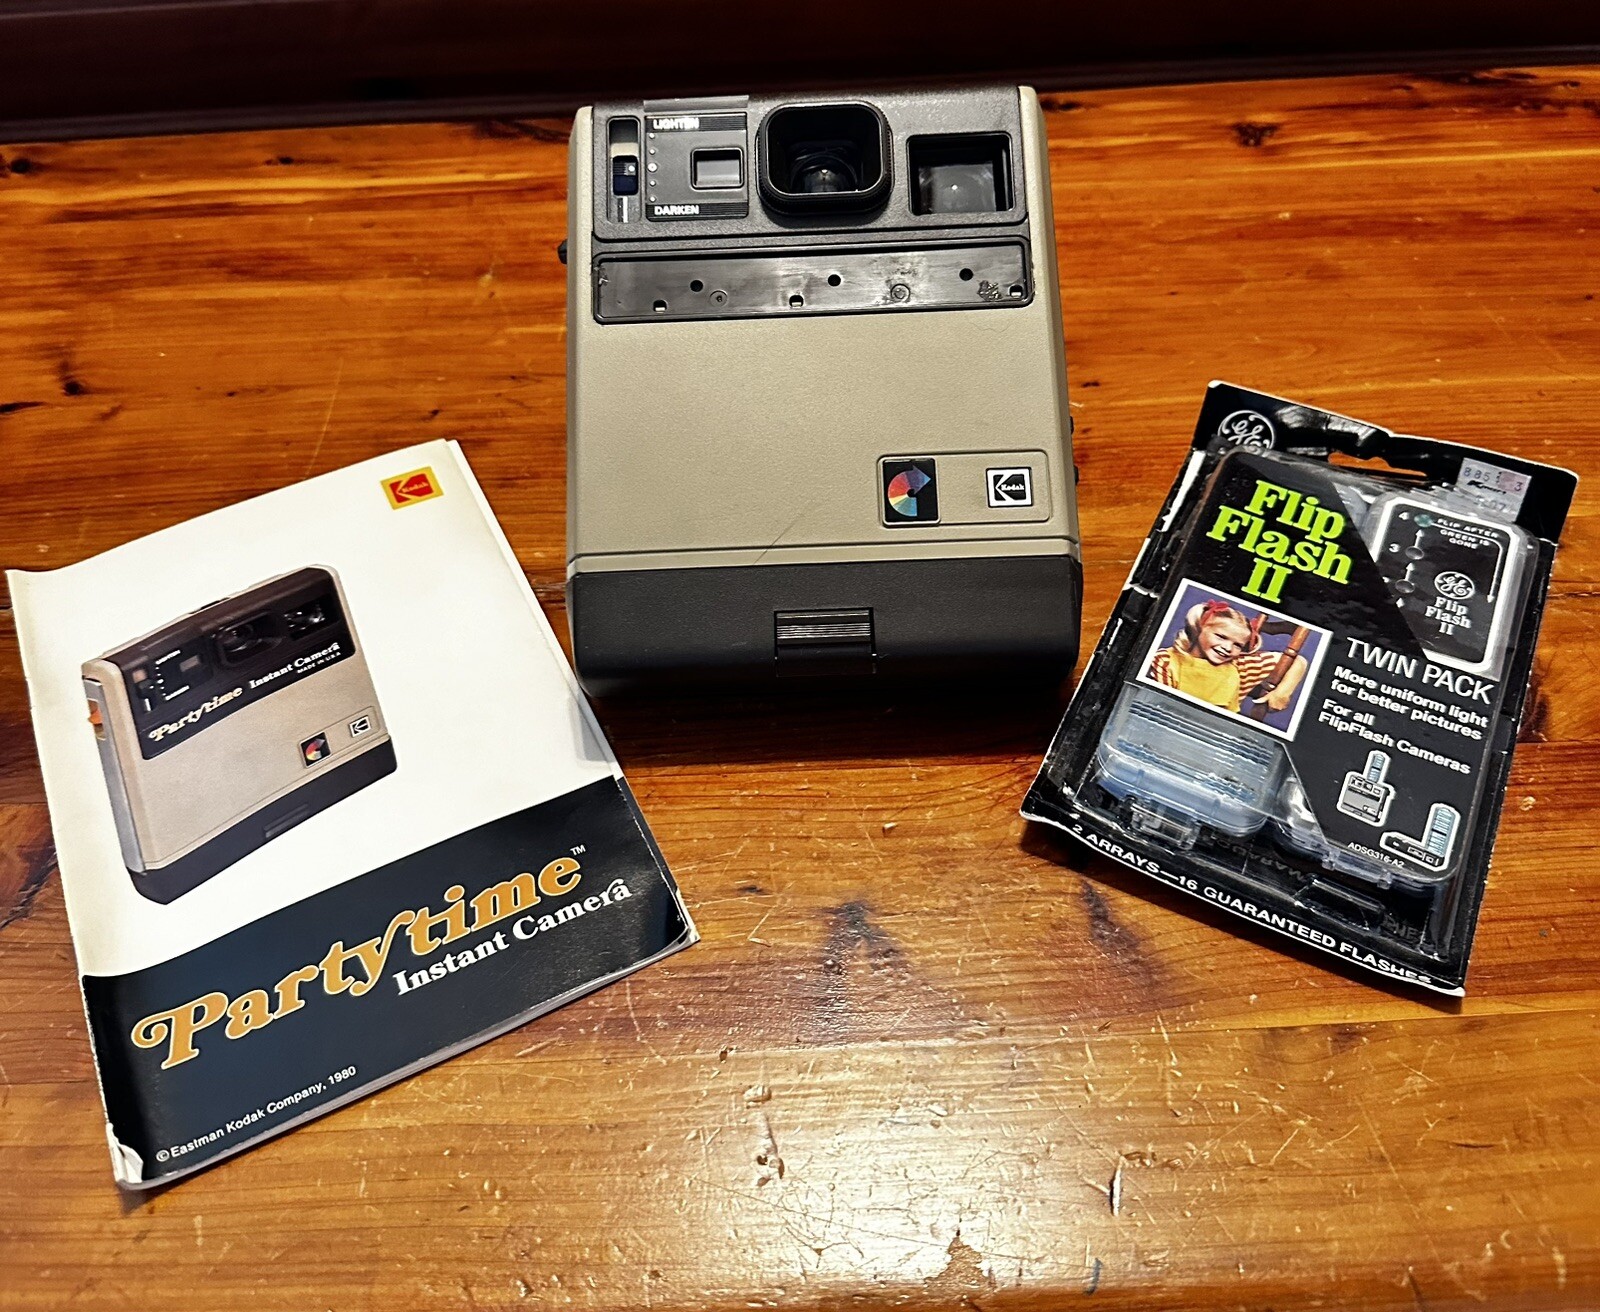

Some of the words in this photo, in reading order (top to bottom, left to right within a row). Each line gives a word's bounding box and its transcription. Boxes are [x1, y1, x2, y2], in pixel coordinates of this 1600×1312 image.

[653, 117, 700, 130] LIGHTEN
[654, 205, 700, 216] DARKEN
[1000, 482, 1025, 492] Kodak
[1244, 479, 1347, 544] Flip
[1399, 511, 1410, 521] 4
[1437, 518, 1461, 529] FLIP
[1463, 525, 1500, 539] AFTER
[1440, 529, 1477, 543] GREEN
[1479, 538, 1491, 547] IS
[1206, 505, 1352, 585] Flash
[1388, 543, 1400, 553] 3
[1448, 537, 1479, 550] GONE
[1241, 557, 1294, 604] II
[1425, 605, 1472, 629] Flash
[1434, 596, 1468, 616] Flip
[1439, 621, 1456, 636] II
[1347, 636, 1419, 679] TWIN
[1422, 663, 1495, 705] PACK
[148, 687, 243, 742] Partytime
[249, 663, 293, 689] Instant
[293, 641, 341, 668] Camera
[1334, 665, 1378, 690] More
[1380, 682, 1446, 713] uniform
[1449, 704, 1489, 729] light
[1322, 698, 1353, 717] For
[1353, 712, 1376, 727] all
[1331, 678, 1358, 696] for
[1356, 687, 1410, 715] better
[1410, 708, 1483, 741] pictures
[1318, 711, 1396, 749] FlipFlash
[1396, 739, 1472, 775] Cameras
[1347, 841, 1406, 869] ADSG316-A2
[1072, 823, 1084, 834] 2
[1203, 886, 1337, 949] GUARANTEED
[1340, 942, 1432, 984] FLASHES
[393, 931, 510, 996] Instant
[512, 878, 633, 941] Camera
[131, 857, 582, 1070] Partytime
[226, 1108, 266, 1134] Kodak
[266, 1081, 327, 1114] Company,
[327, 1064, 357, 1086] 1980
